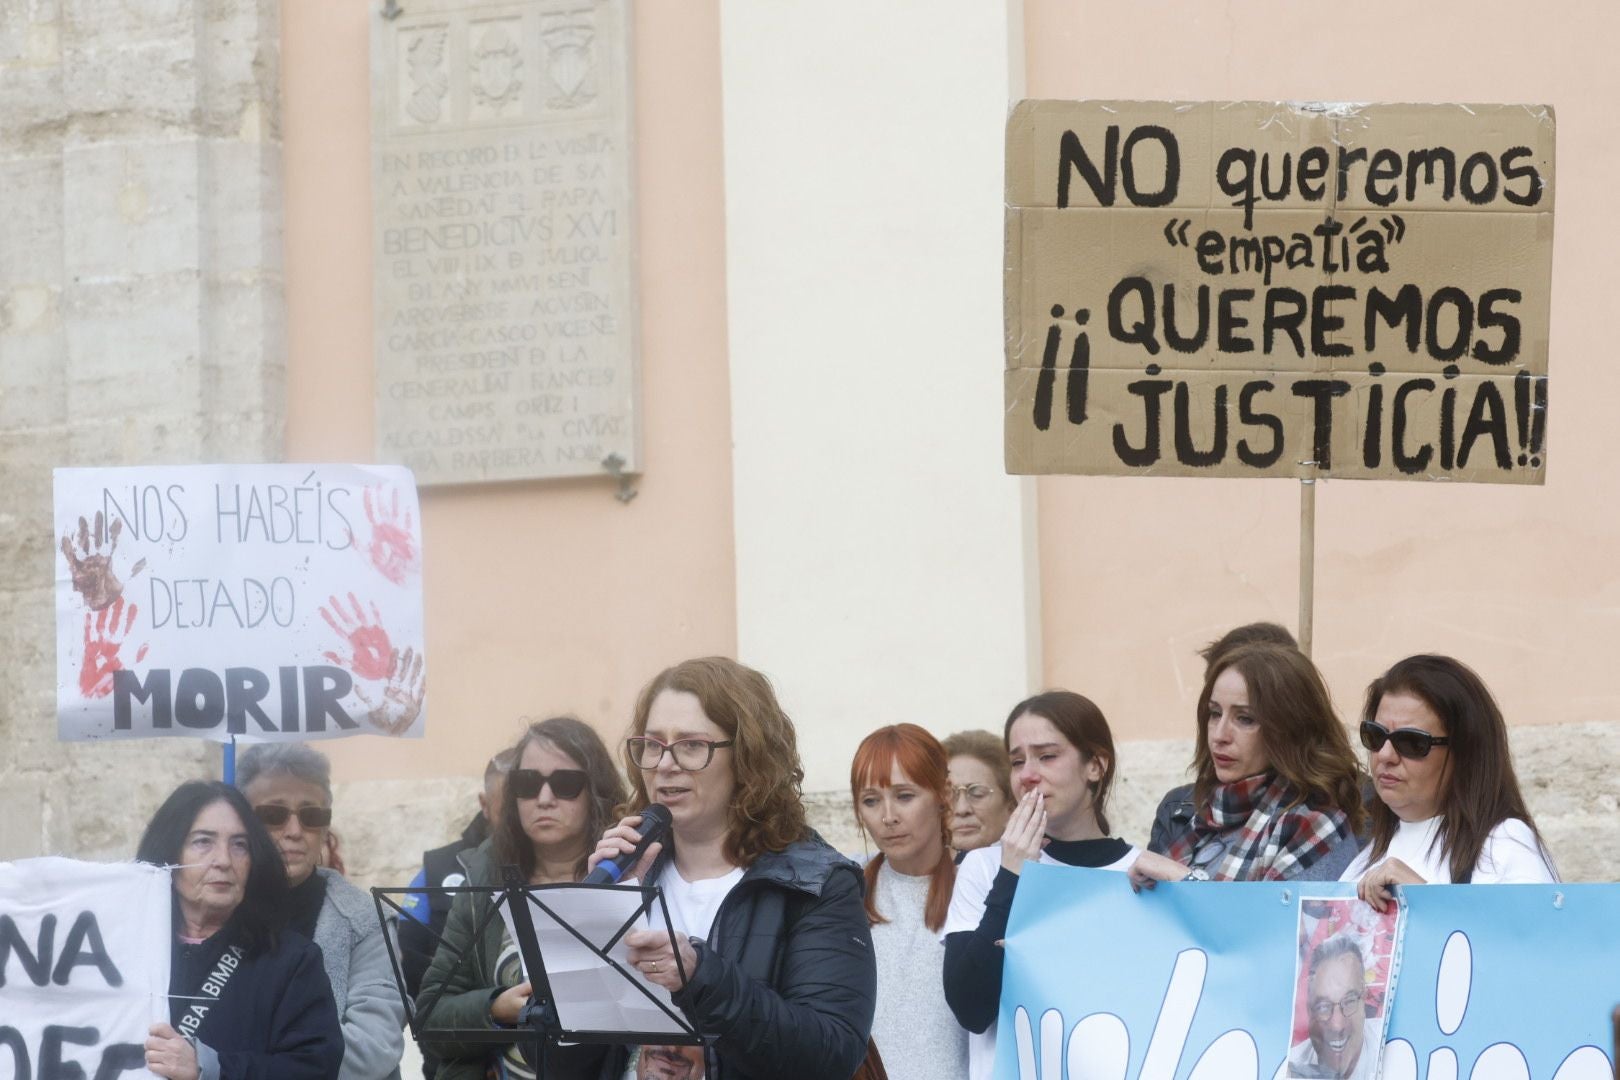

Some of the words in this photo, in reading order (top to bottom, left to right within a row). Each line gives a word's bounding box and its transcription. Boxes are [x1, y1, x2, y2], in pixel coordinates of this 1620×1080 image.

[381, 153, 411, 173] EN
[417, 145, 498, 170] RECORD
[1058, 125, 1180, 209] NO
[1217, 146, 1544, 229] queremos
[391, 181, 408, 197] A
[541, 187, 606, 210] PAPA
[566, 209, 617, 240] XVI
[1108, 277, 1522, 365] QUEREMOS
[103, 484, 188, 544] NOS
[214, 470, 352, 550] HABÉIS
[150, 576, 295, 629] DEJADO
[112, 665, 360, 734] MORIR
[201, 945, 246, 997] BIMBA
